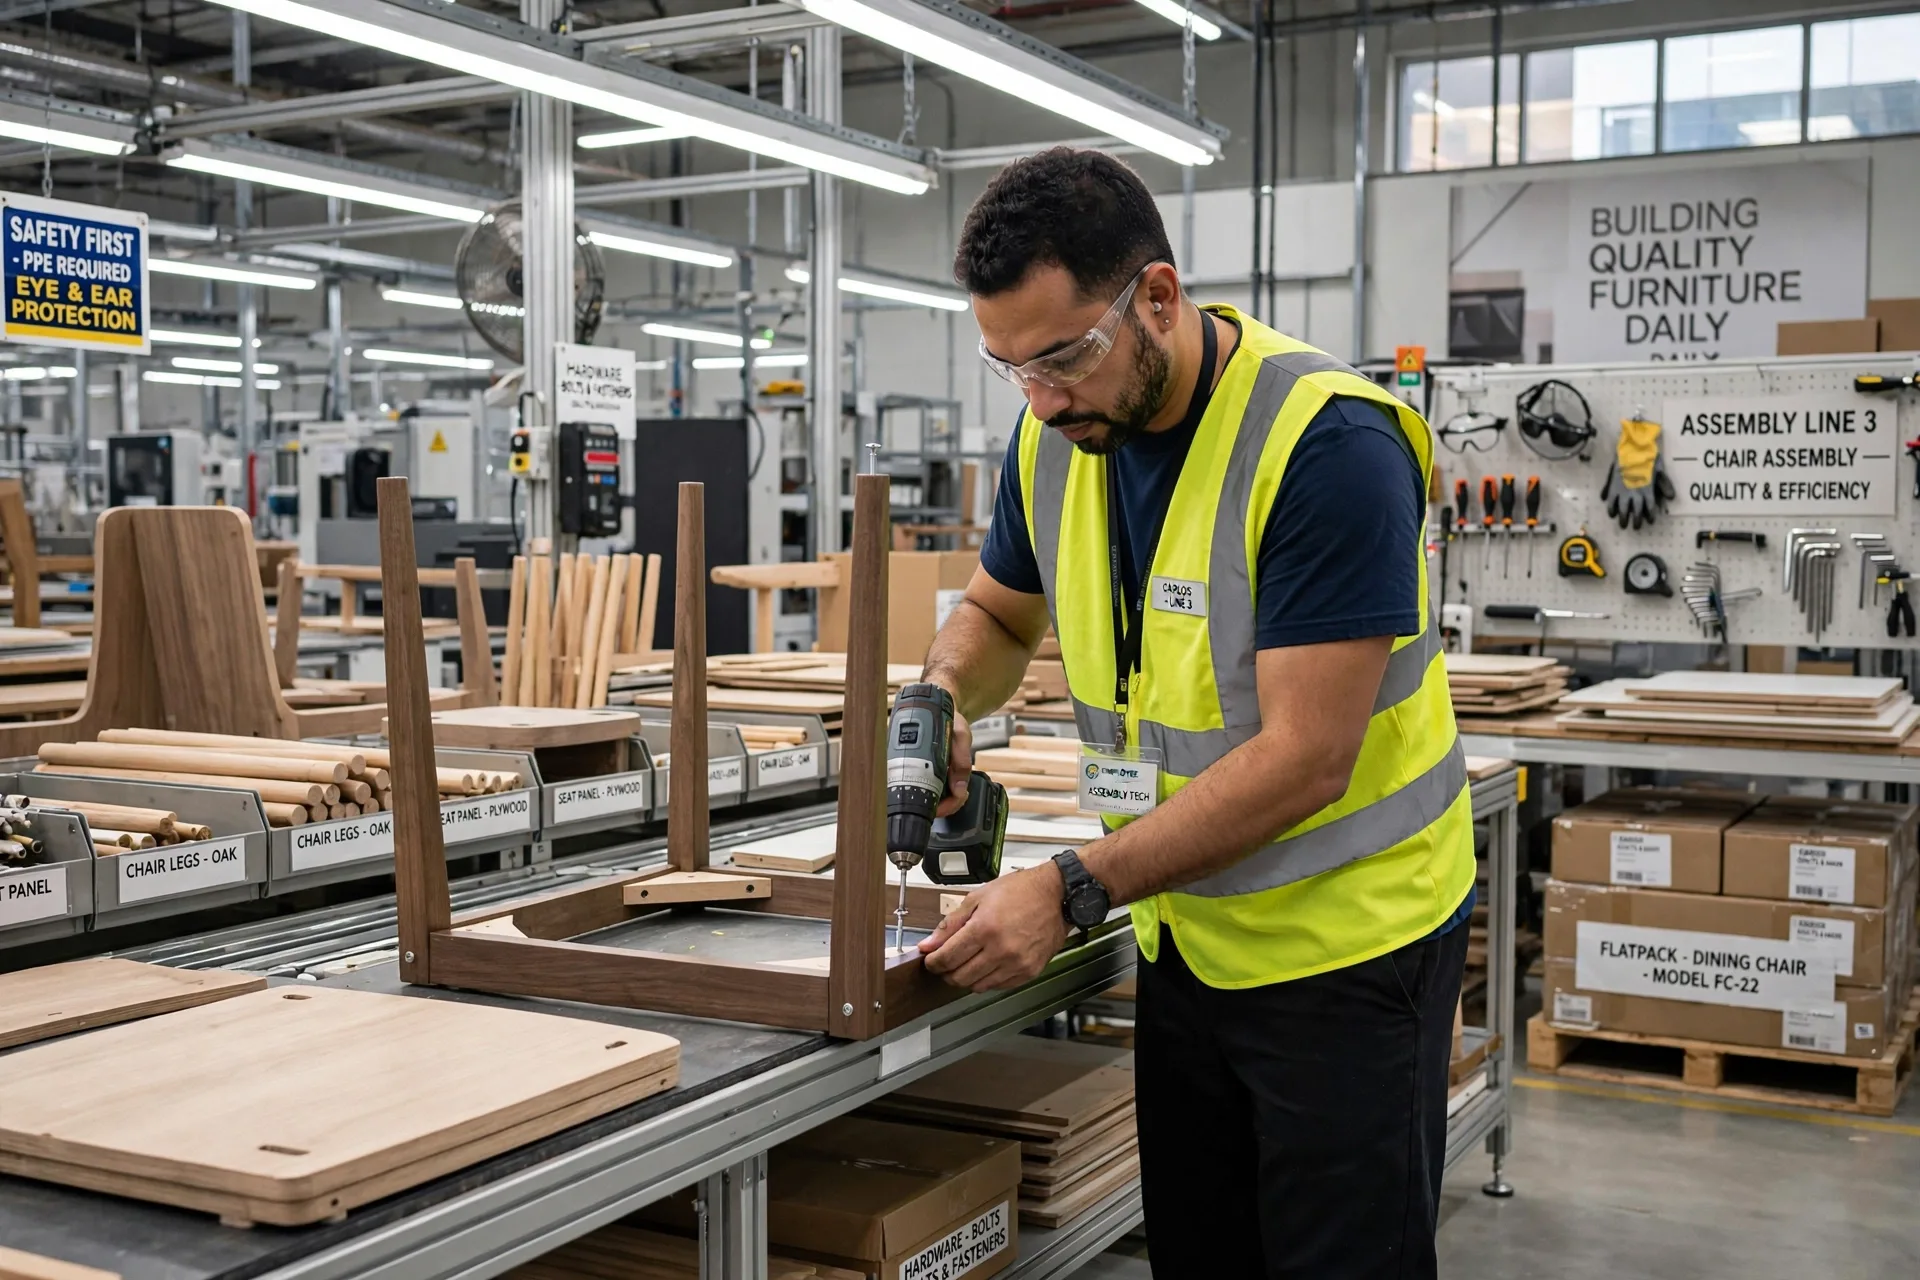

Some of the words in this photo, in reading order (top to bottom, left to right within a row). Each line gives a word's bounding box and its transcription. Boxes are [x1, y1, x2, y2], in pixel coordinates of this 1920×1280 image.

[1591, 198, 1758, 237] BUILDING
[10, 216, 81, 250] SAFETY
[85, 227, 134, 257] FIRST
[23, 250, 53, 273] PPE
[57, 255, 132, 283] REQUIRED
[1589, 235, 1754, 274] QUALITY
[16, 275, 59, 299] EYE
[68, 281, 83, 302] &
[91, 284, 133, 308] EAR
[1590, 270, 1801, 309] FURNITURE
[12, 298, 136, 331] PROTECTION
[1626, 311, 1728, 344] DAILY
[1681, 412, 1797, 435] ASSEMBLY
[1805, 410, 1856, 433] LINE
[1864, 410, 1877, 433] 3
[1703, 449, 1757, 468] CHAIR
[1763, 448, 1857, 468] ASSEMBLY
[1690, 482, 1757, 501] QUALITY
[1762, 482, 1772, 500] &
[1779, 481, 1871, 500] EFFICIENCY
[558, 789, 576, 805] SEAT
[578, 787, 600, 801] PANEL
[606, 781, 640, 797] PLYWOOD
[1130, 791, 1150, 801] TECH
[440, 811, 455, 825] EAT
[458, 807, 482, 823] PANEL
[489, 801, 528, 817] PLYWOOD
[297, 830, 332, 849] CHAIR
[334, 826, 360, 843] LEGS
[369, 821, 391, 836] OAK
[126, 859, 166, 878] CHAIR
[170, 853, 200, 871] LEGS
[211, 847, 238, 864] OAK
[9, 879, 52, 899] PANEL
[1600, 941, 1678, 963] FLATPACK
[1693, 950, 1750, 971] DINING
[1756, 956, 1807, 976] CHAIR
[1652, 968, 1709, 989] MODEL
[1714, 974, 1760, 994] FC-22
[904, 1231, 963, 1280] HARDWARE
[971, 1209, 1000, 1240] BOLTS
[942, 1263, 950, 1280] &
[952, 1227, 1006, 1275] FASTENERS
